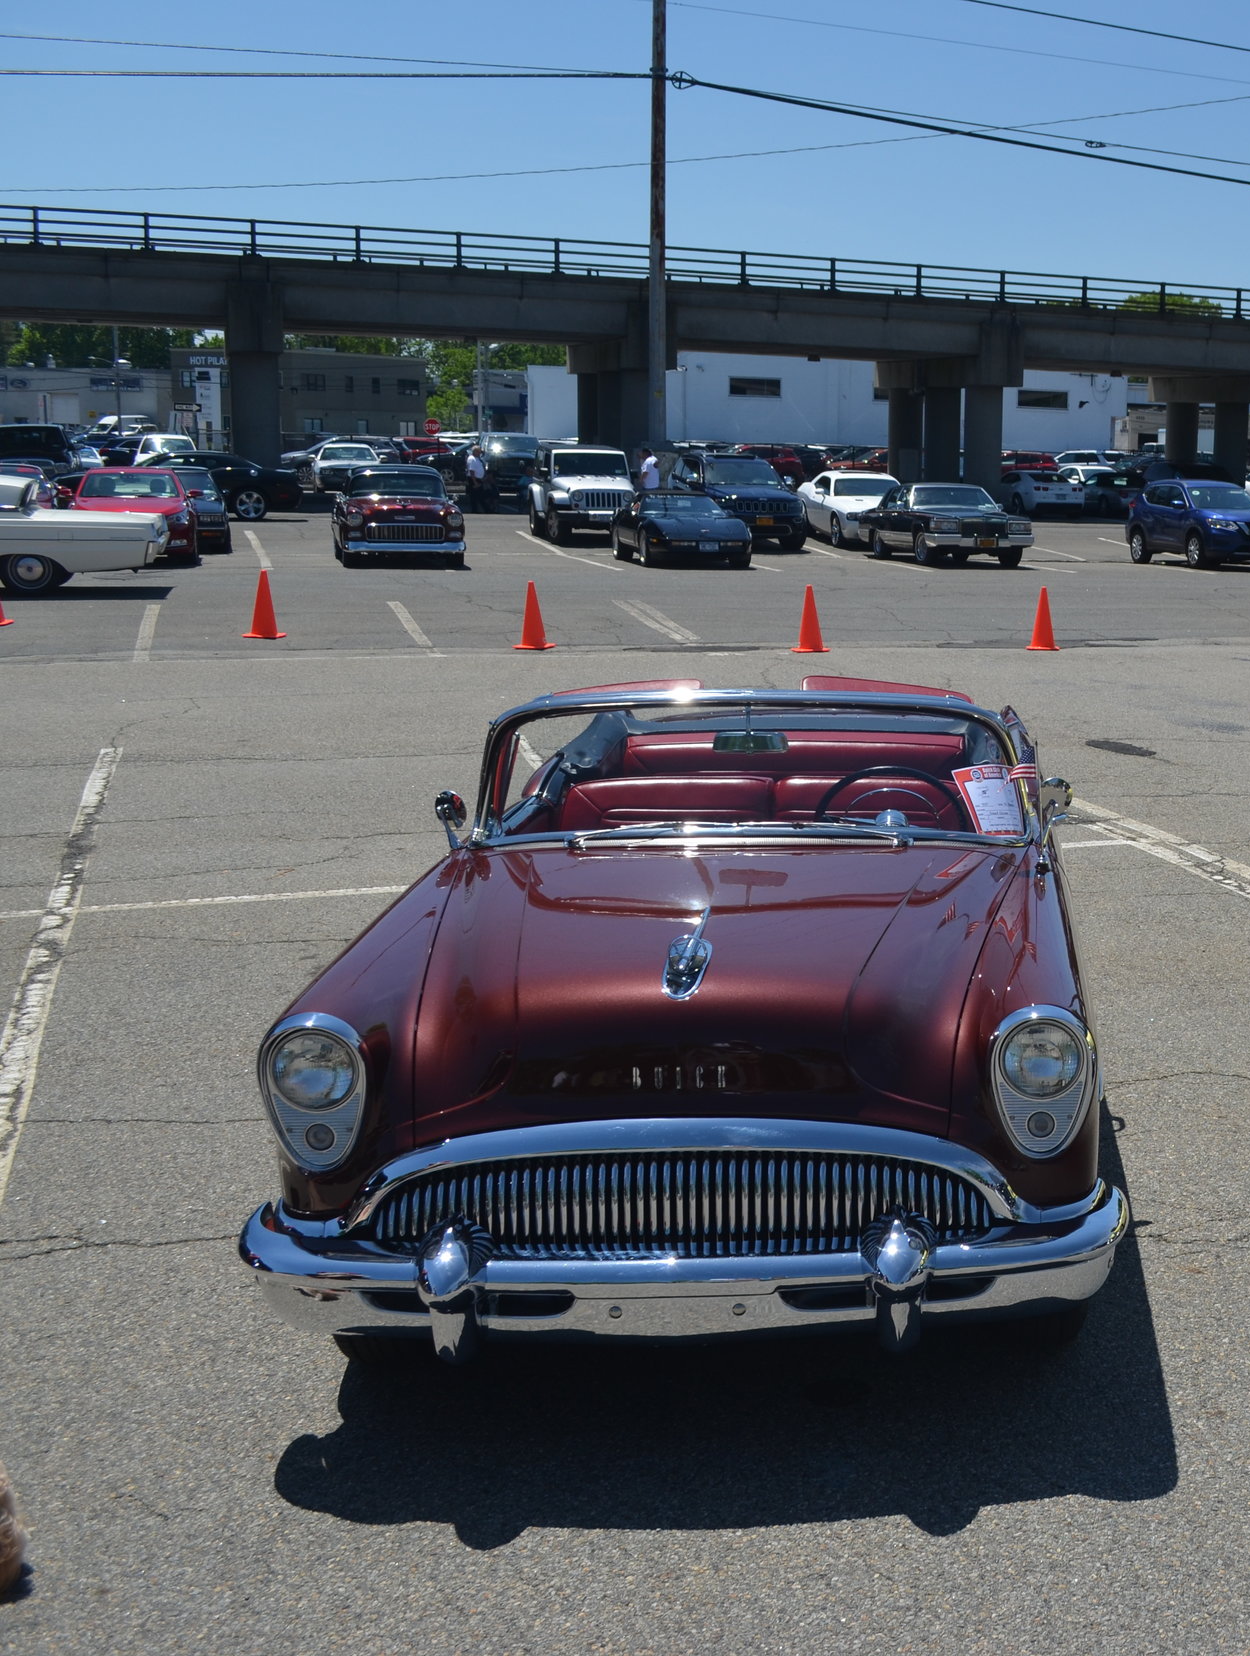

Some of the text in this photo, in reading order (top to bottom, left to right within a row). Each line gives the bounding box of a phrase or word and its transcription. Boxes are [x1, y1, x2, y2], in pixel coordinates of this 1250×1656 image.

[190, 356, 206, 365] HOT
[424, 423, 440, 431] STOP
[632, 1065, 726, 1089] BUICK
